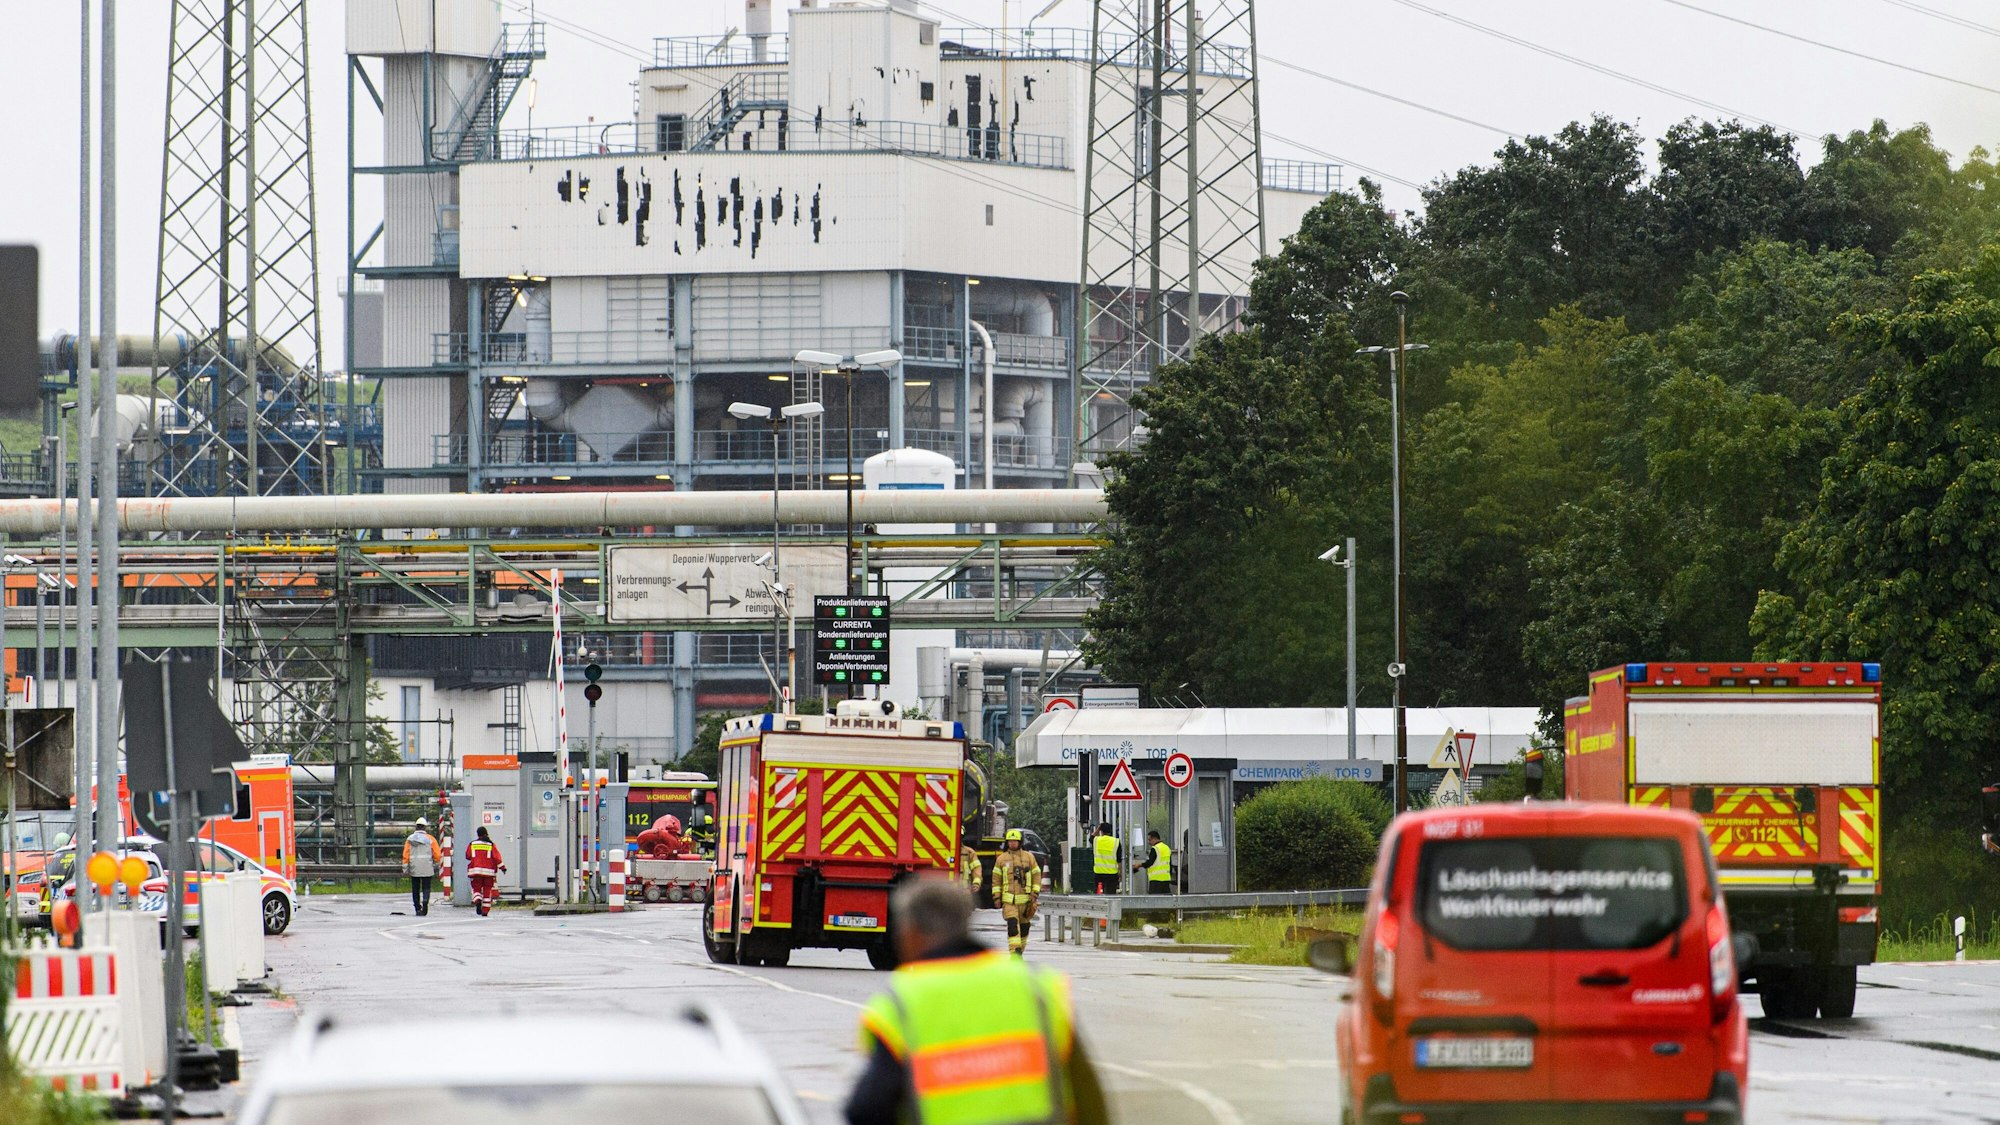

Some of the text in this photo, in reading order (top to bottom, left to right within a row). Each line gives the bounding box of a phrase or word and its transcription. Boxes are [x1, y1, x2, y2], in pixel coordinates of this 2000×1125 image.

[673, 553, 760, 566] Deponie/Wupperverba
[616, 574, 676, 587] Verbrennungs-
[617, 589, 648, 601] anlagen
[817, 599, 888, 608] Produktanlieferungen
[817, 631, 887, 640] Sonderanlieferungen
[829, 653, 875, 662] Anlieferungen
[816, 662, 888, 672] Deponie/Verbrennung
[1146, 748, 1168, 759] TOR
[1239, 767, 1372, 778] CHEMPARK TOR 9
[628, 813, 649, 825] 112
[1751, 826, 1777, 842] 112
[1438, 867, 1673, 893] Löschanlagenservice
[1440, 894, 1609, 918] Werkfeuerwehr
